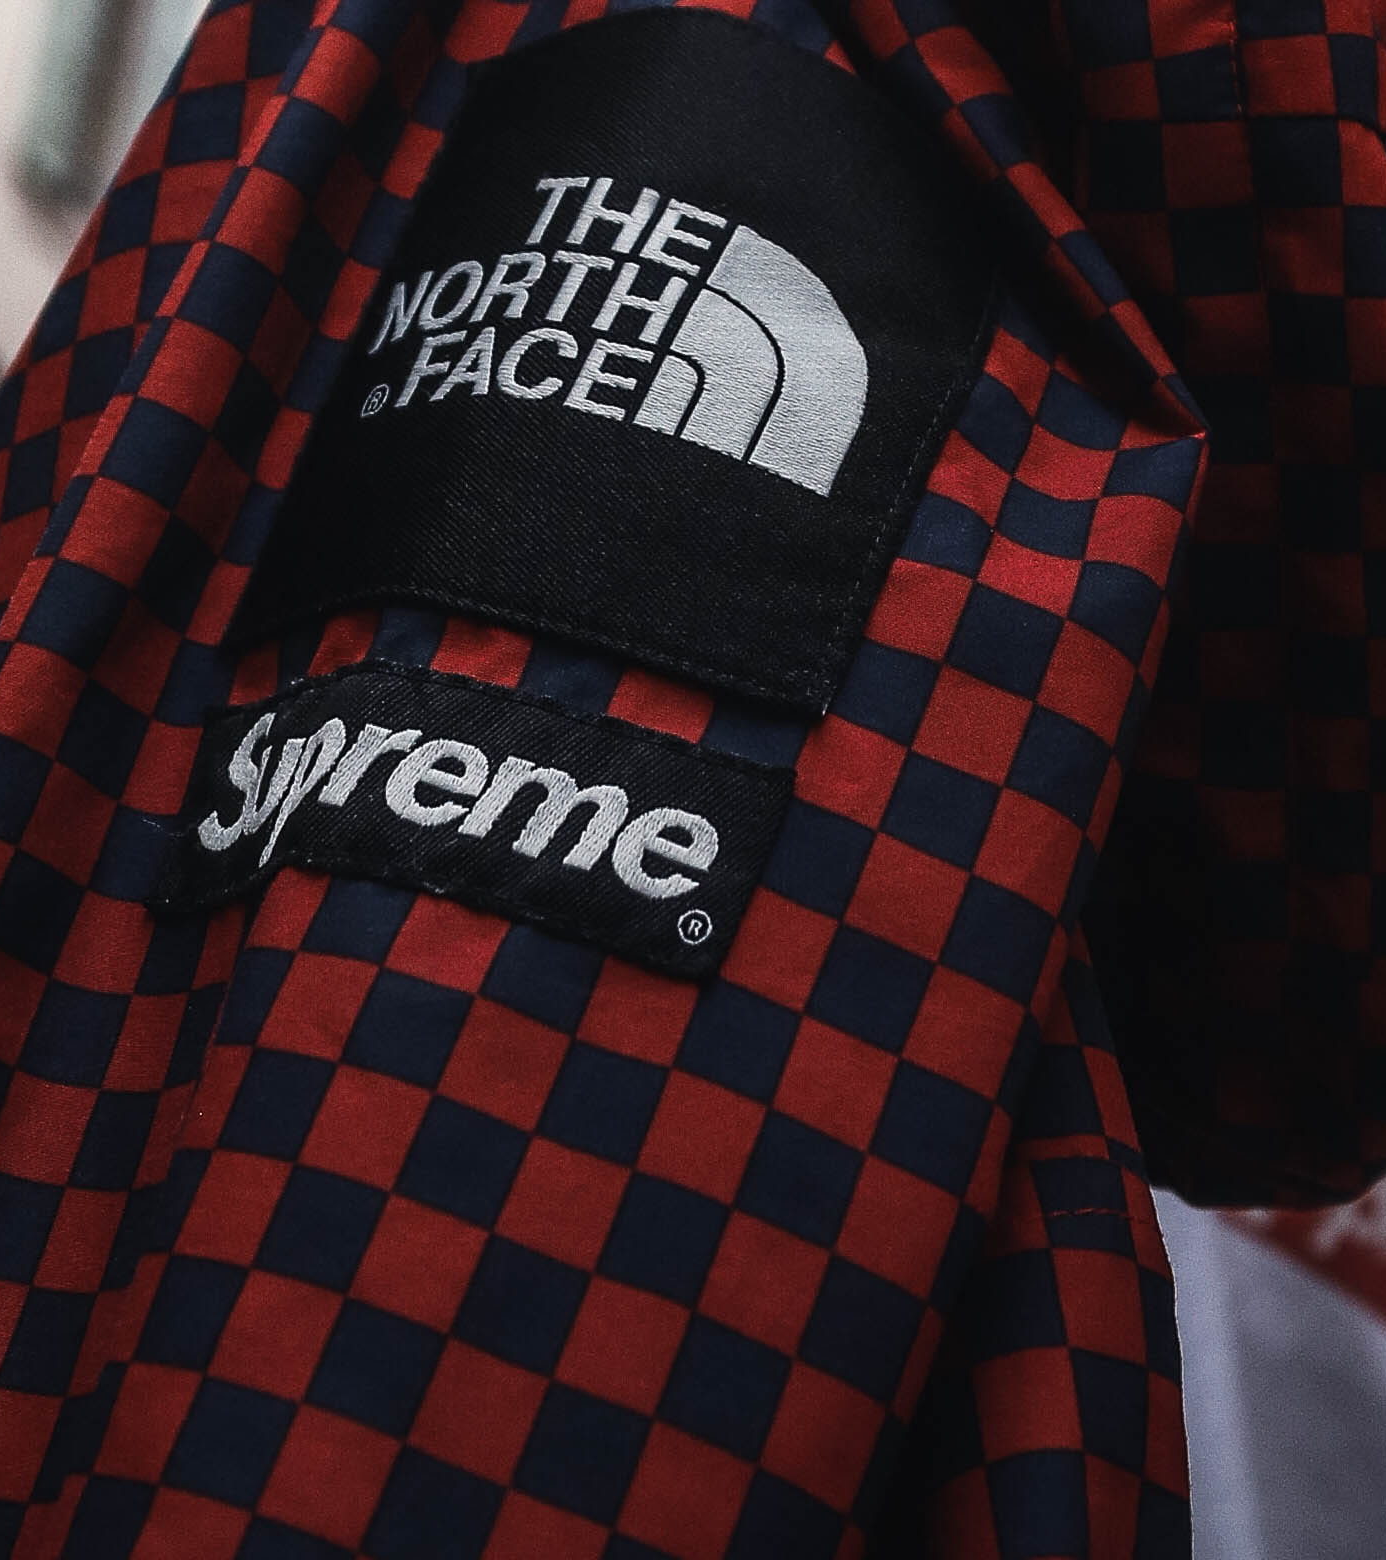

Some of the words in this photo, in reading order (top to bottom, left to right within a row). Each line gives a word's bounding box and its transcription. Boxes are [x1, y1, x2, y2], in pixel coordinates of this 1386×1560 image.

[526, 177, 727, 276] THE
[369, 250, 688, 353] NORTH
[395, 327, 657, 421] FACE
[198, 712, 719, 900] Supreme
